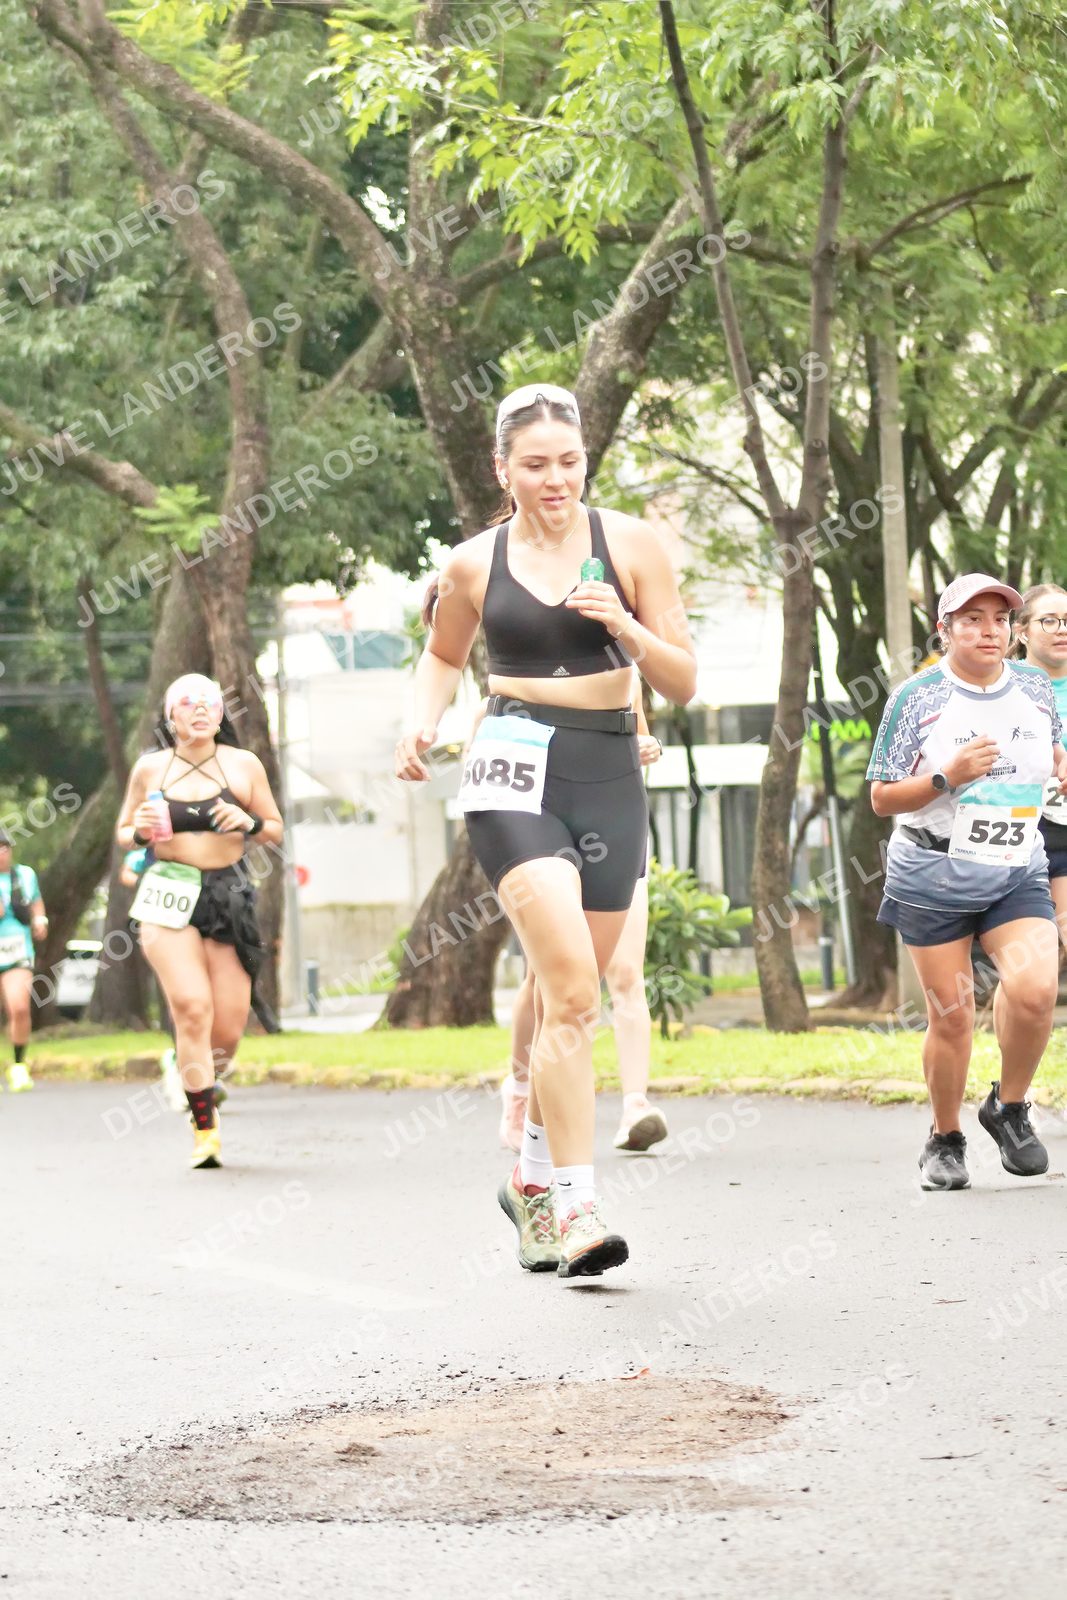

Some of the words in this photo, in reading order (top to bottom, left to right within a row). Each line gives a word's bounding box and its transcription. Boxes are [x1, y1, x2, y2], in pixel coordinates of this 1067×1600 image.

[1046, 786, 1067, 807] 2
[968, 819, 1026, 846] 523
[143, 887, 190, 913] 2100
